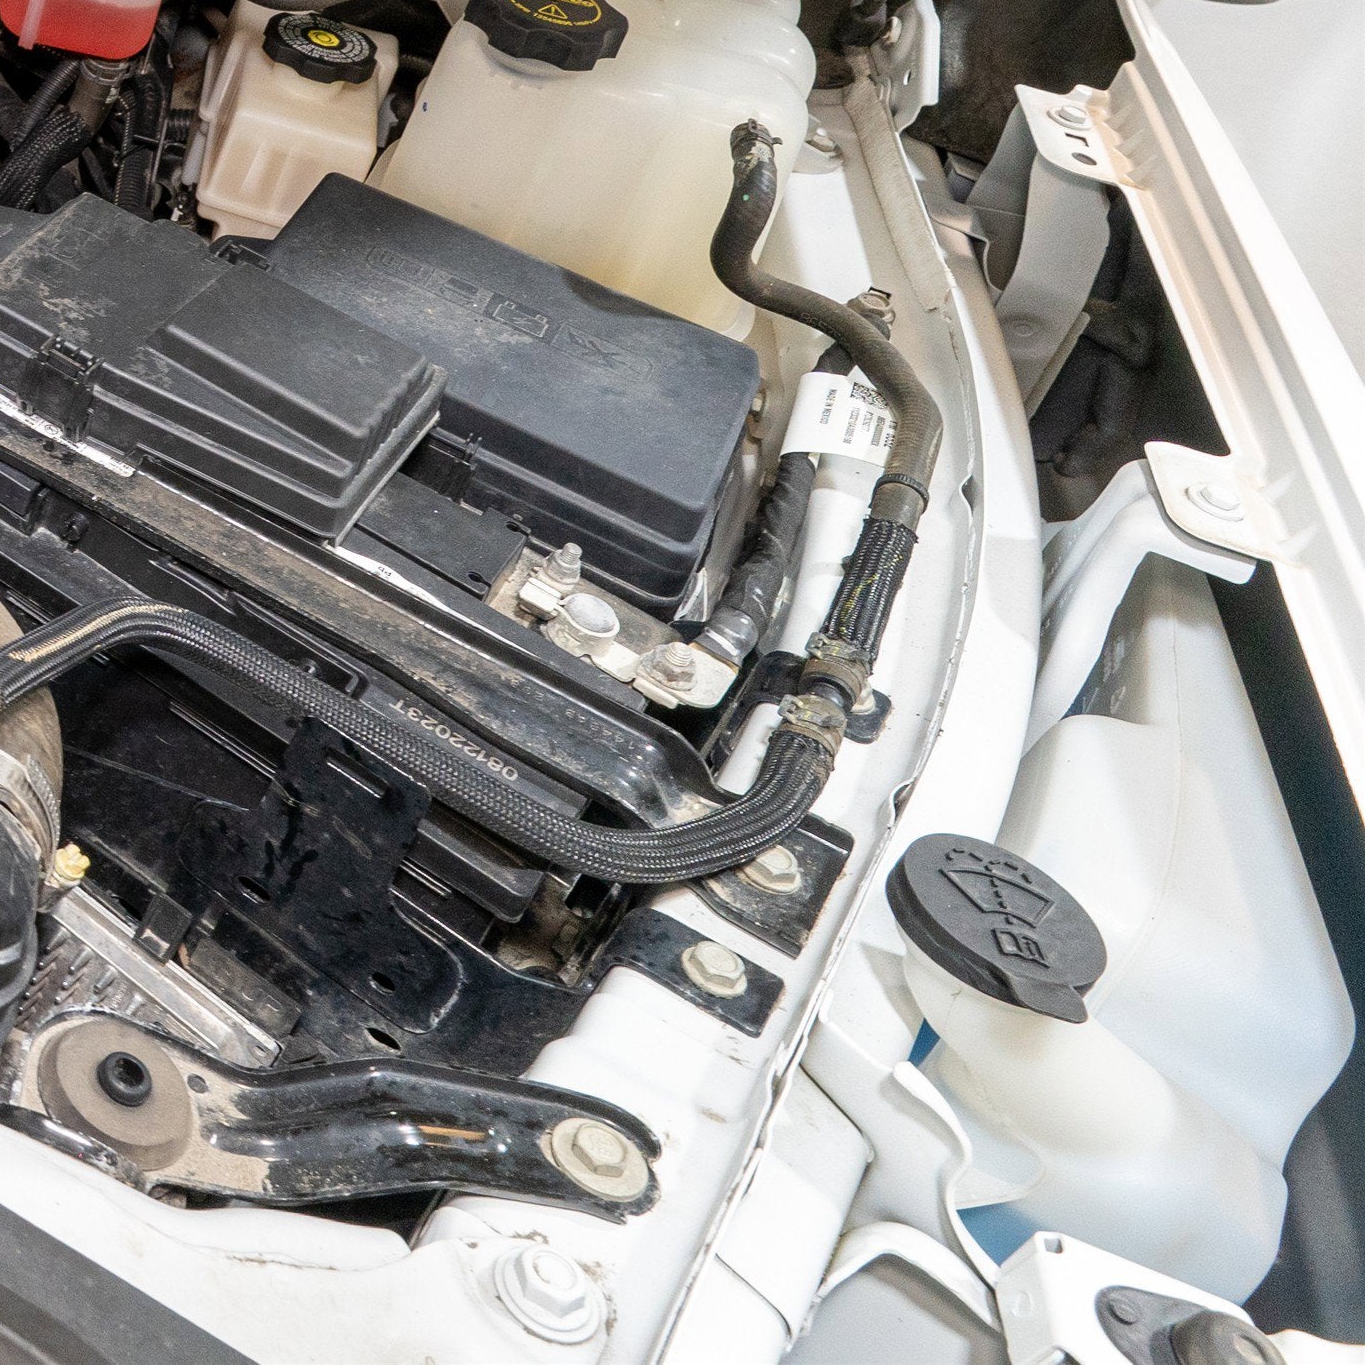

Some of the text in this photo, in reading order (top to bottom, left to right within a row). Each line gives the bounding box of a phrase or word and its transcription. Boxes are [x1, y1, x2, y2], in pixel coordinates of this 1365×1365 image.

[826, 389, 837, 401] MADE
[820, 407, 832, 424] MEXICO
[388, 699, 519, 781] 08122023T
